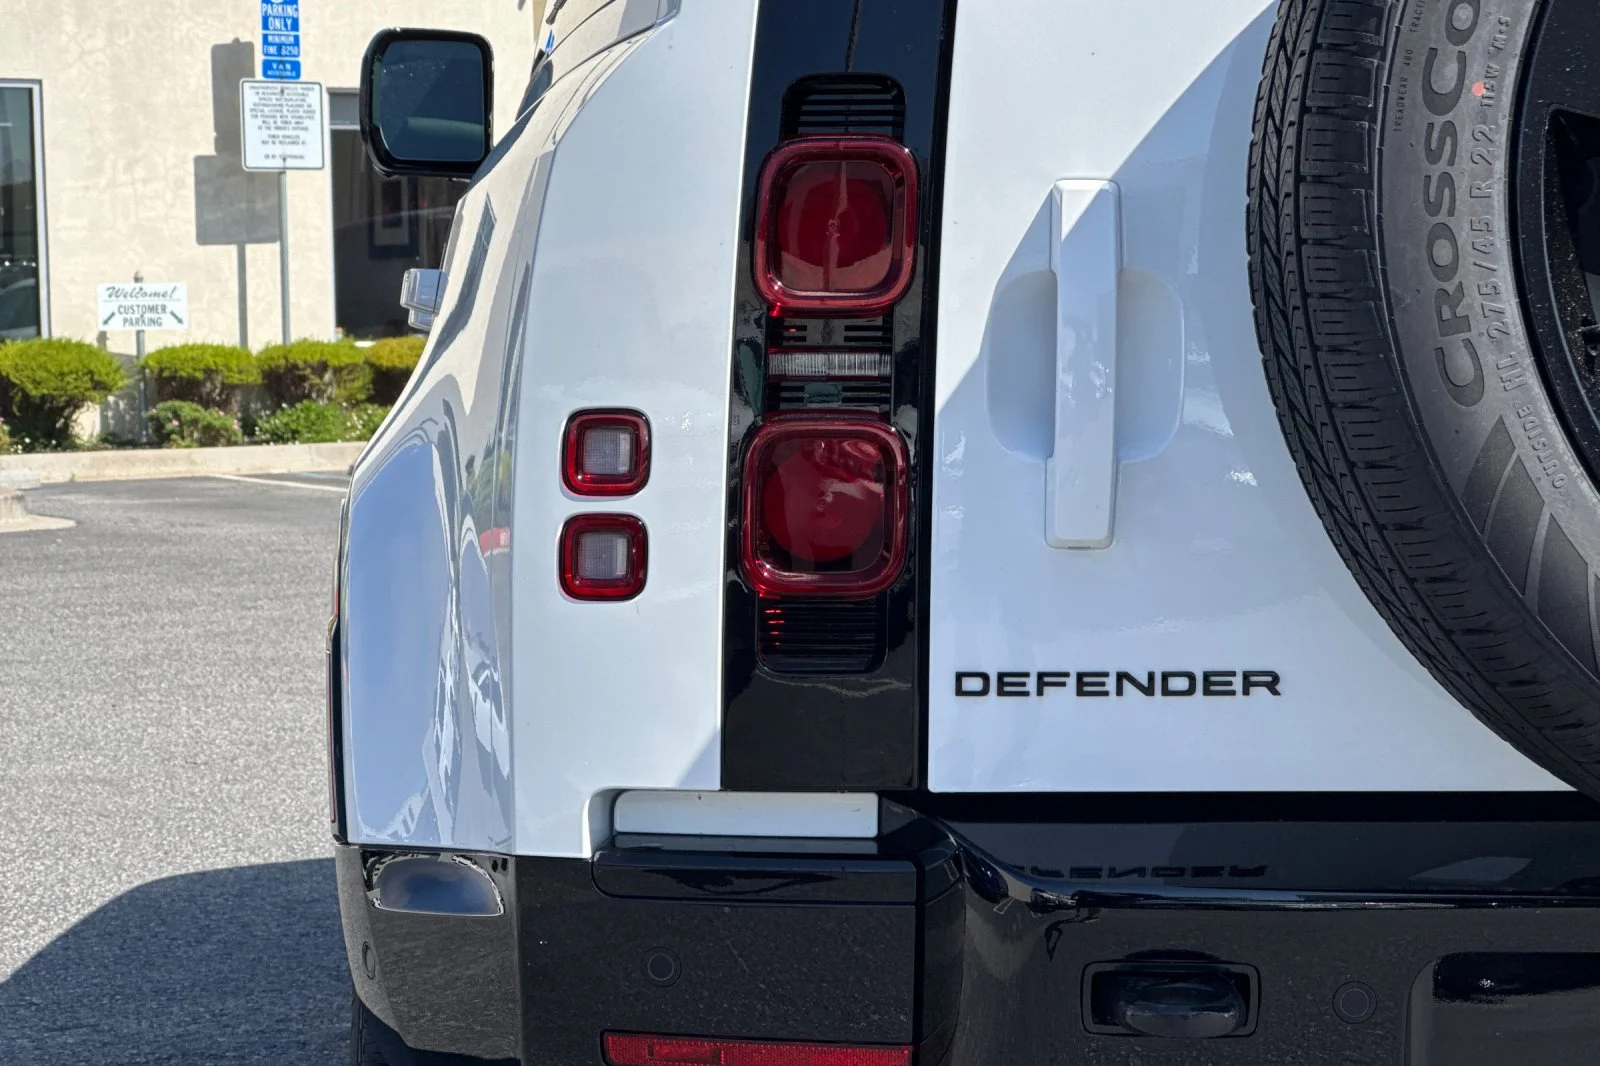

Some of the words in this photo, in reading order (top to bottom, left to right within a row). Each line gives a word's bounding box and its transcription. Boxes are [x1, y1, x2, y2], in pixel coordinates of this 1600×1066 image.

[262, 3, 298, 18] PARKING
[268, 17, 293, 31] ONLY
[1394, 76, 1409, 132] TREADWEAR
[105, 285, 177, 299] Welcome!
[117, 303, 168, 316] CUSTOMER
[123, 316, 164, 328] PARKING
[1516, 404, 1568, 490] OUTSIDE
[955, 670, 1282, 697] DEFENDER
